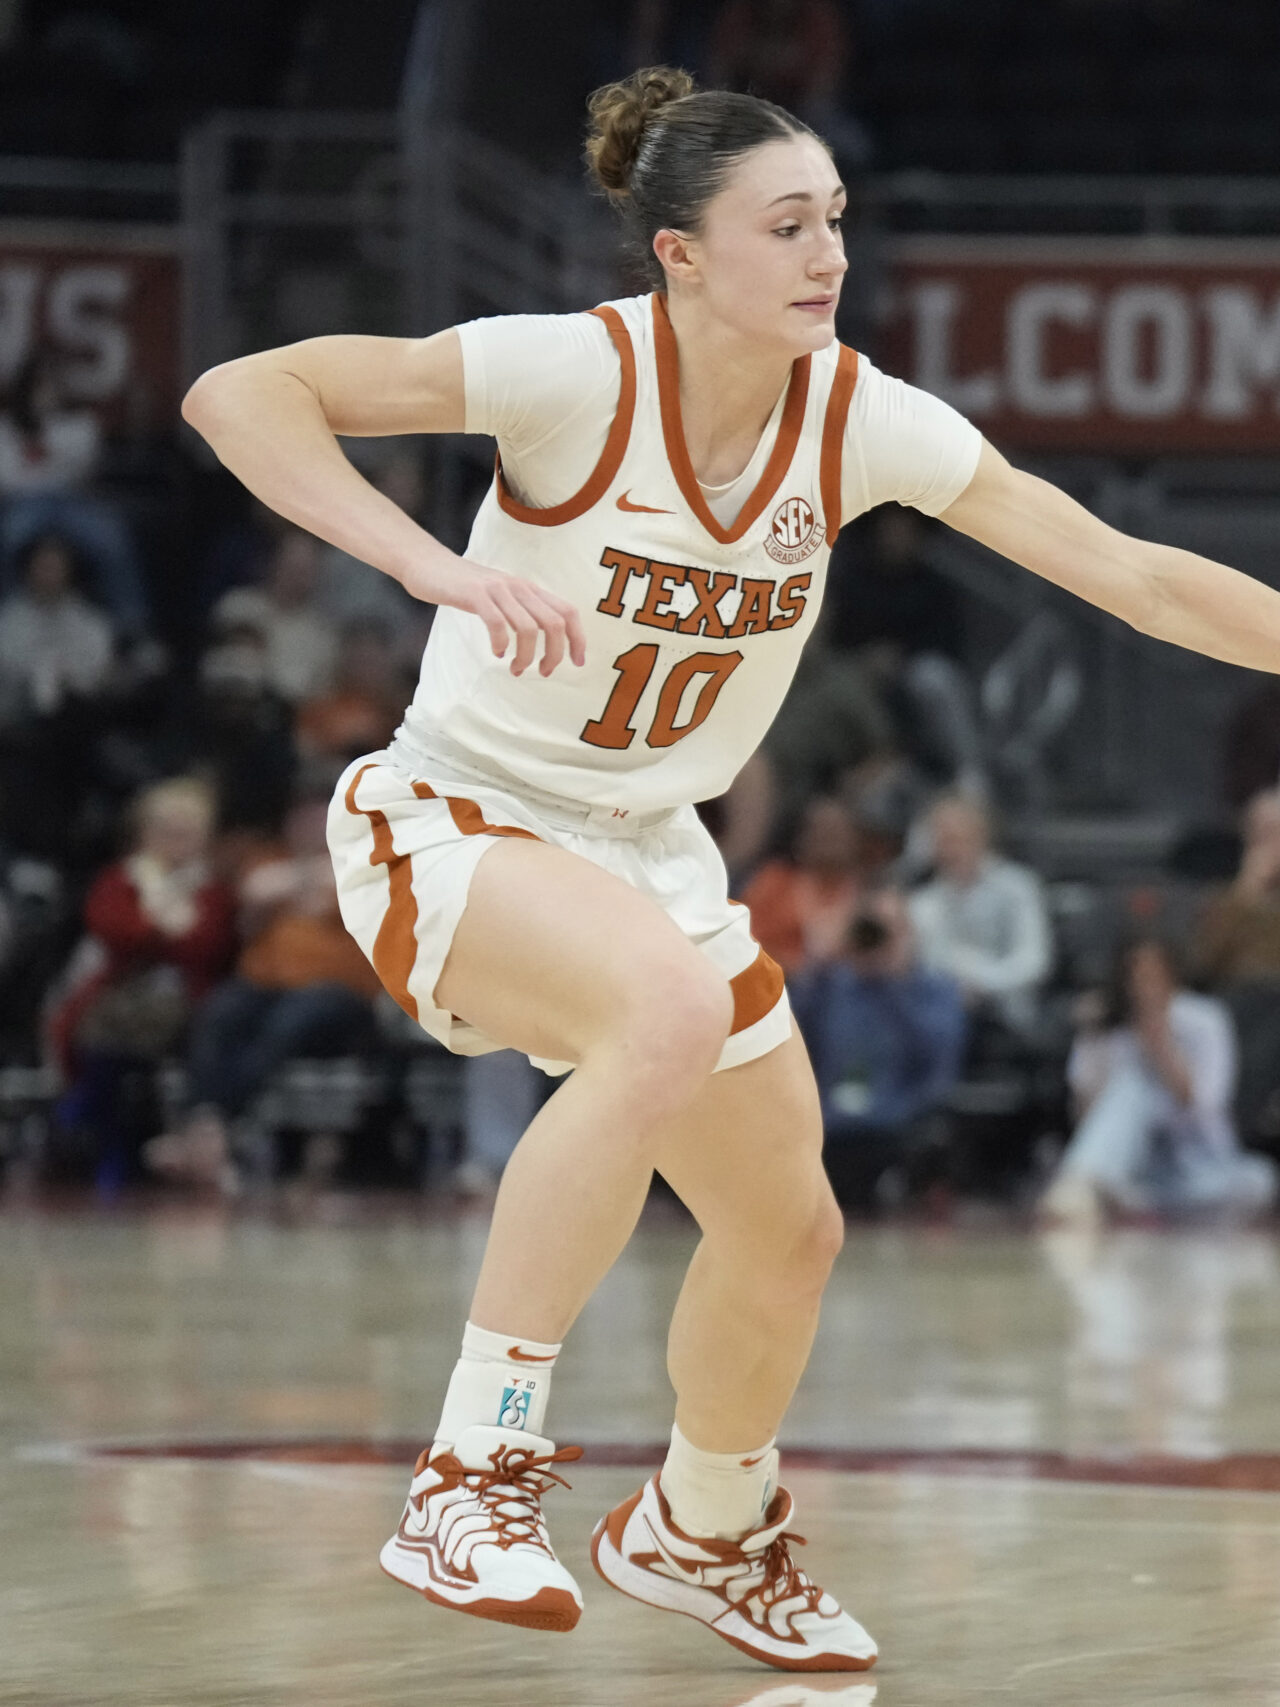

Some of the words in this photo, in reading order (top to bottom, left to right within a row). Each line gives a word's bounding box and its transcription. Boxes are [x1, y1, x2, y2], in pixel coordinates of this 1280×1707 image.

[770, 538, 818, 562] GRADUATE
[773, 499, 812, 548] SEC
[597, 546, 813, 639] TEXAS
[579, 643, 744, 750] 10
